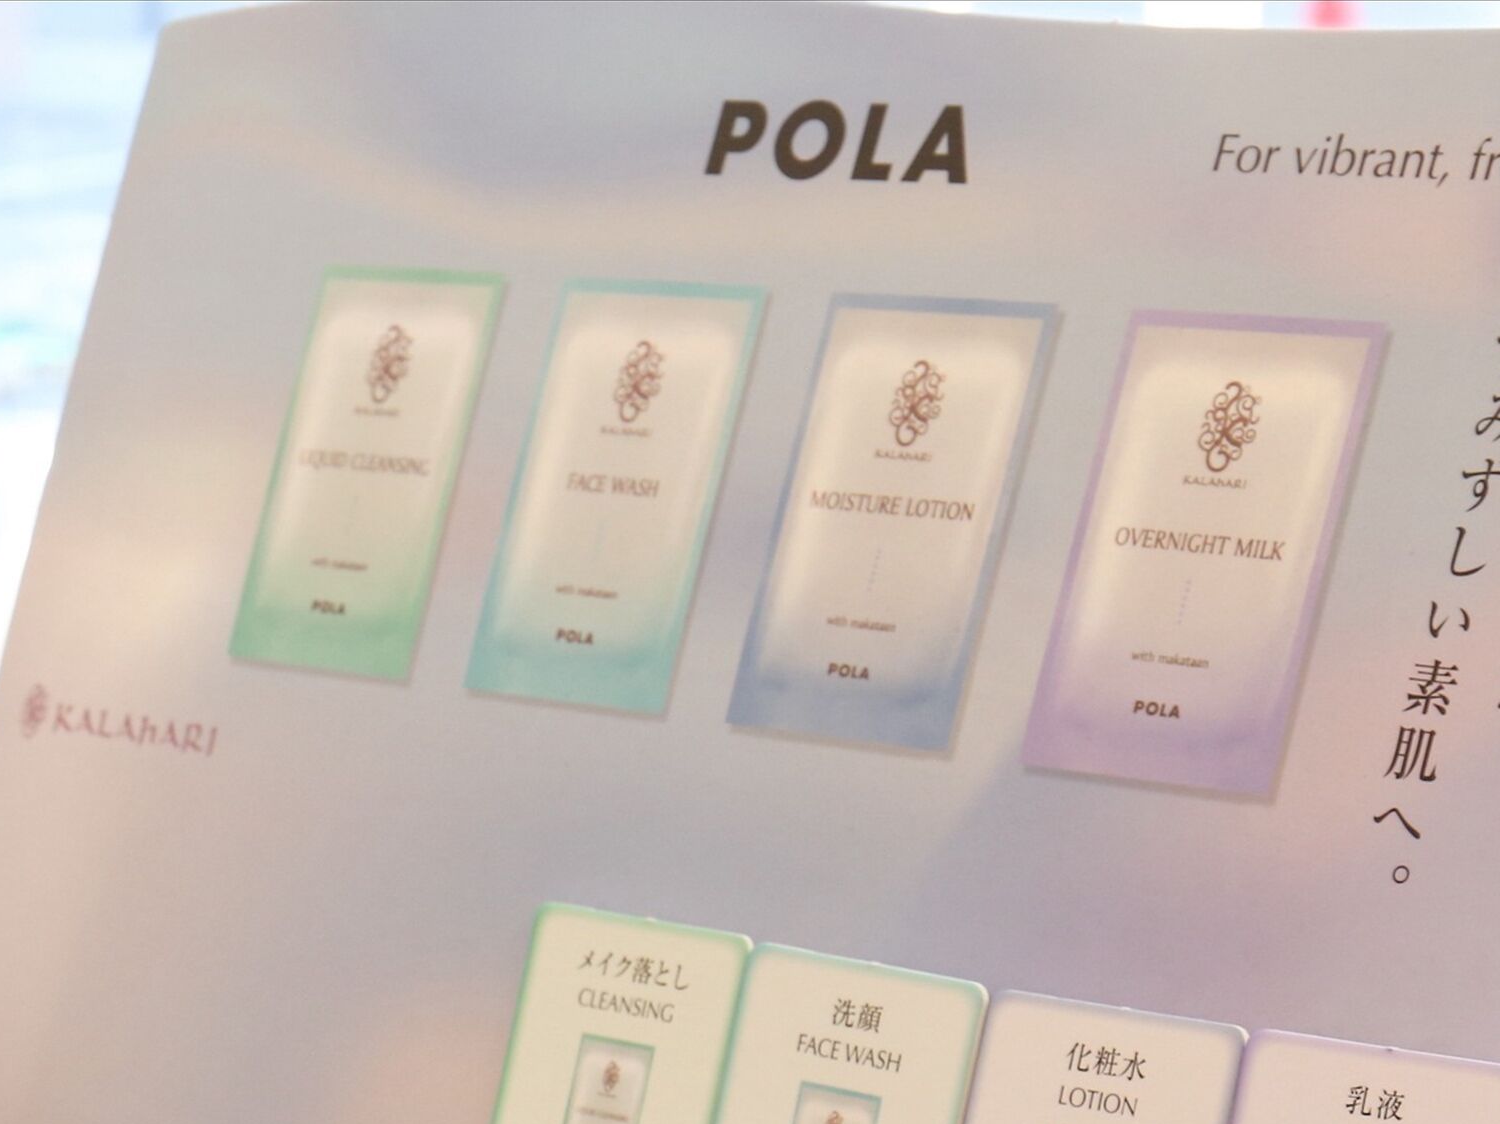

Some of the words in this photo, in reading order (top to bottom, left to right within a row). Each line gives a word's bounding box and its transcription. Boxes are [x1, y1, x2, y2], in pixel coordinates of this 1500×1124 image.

[705, 99, 967, 184] POLA
[1212, 133, 1281, 174] For
[1295, 132, 1449, 188] vibrant,
[567, 471, 606, 493] FACE
[611, 477, 660, 498] WASH
[811, 489, 902, 516] MOISTURE
[906, 499, 976, 521] LOTION
[1114, 526, 1231, 556] OVERNIGHT
[1233, 537, 1287, 561] MILK
[555, 627, 595, 646] POLA
[827, 661, 870, 681] POLA
[1132, 699, 1181, 719] POLA
[578, 950, 690, 991] メイク落とし
[577, 987, 676, 1024] CLEANSING
[831, 998, 884, 1034] 洗顔
[796, 1032, 841, 1060] FACE
[845, 1043, 902, 1073] WASH
[1066, 1041, 1147, 1082] 化粧水
[1058, 1085, 1138, 1118] LOTION
[1345, 1085, 1406, 1122] 乳液
